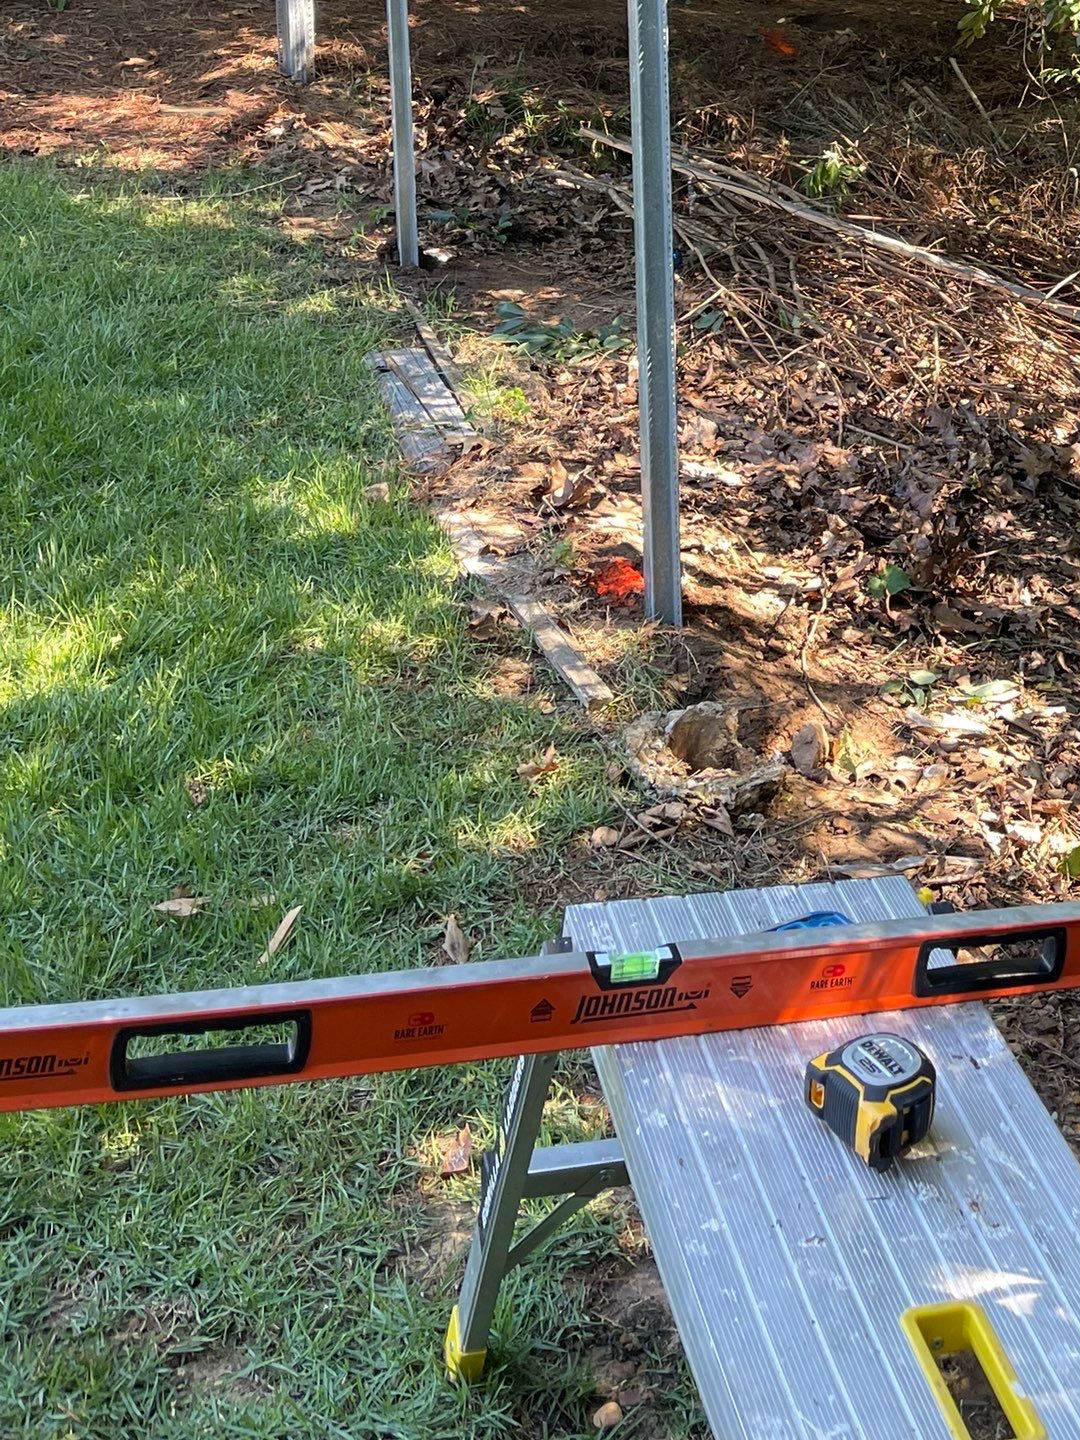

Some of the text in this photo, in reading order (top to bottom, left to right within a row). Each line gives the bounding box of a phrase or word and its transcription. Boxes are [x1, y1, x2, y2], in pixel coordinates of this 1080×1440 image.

[810, 977, 853, 990] RARE EARTH
[570, 987, 677, 1024] JOHNSON
[394, 1024, 445, 1040] RARE EARTH
[861, 1040, 906, 1075] DEWALT
